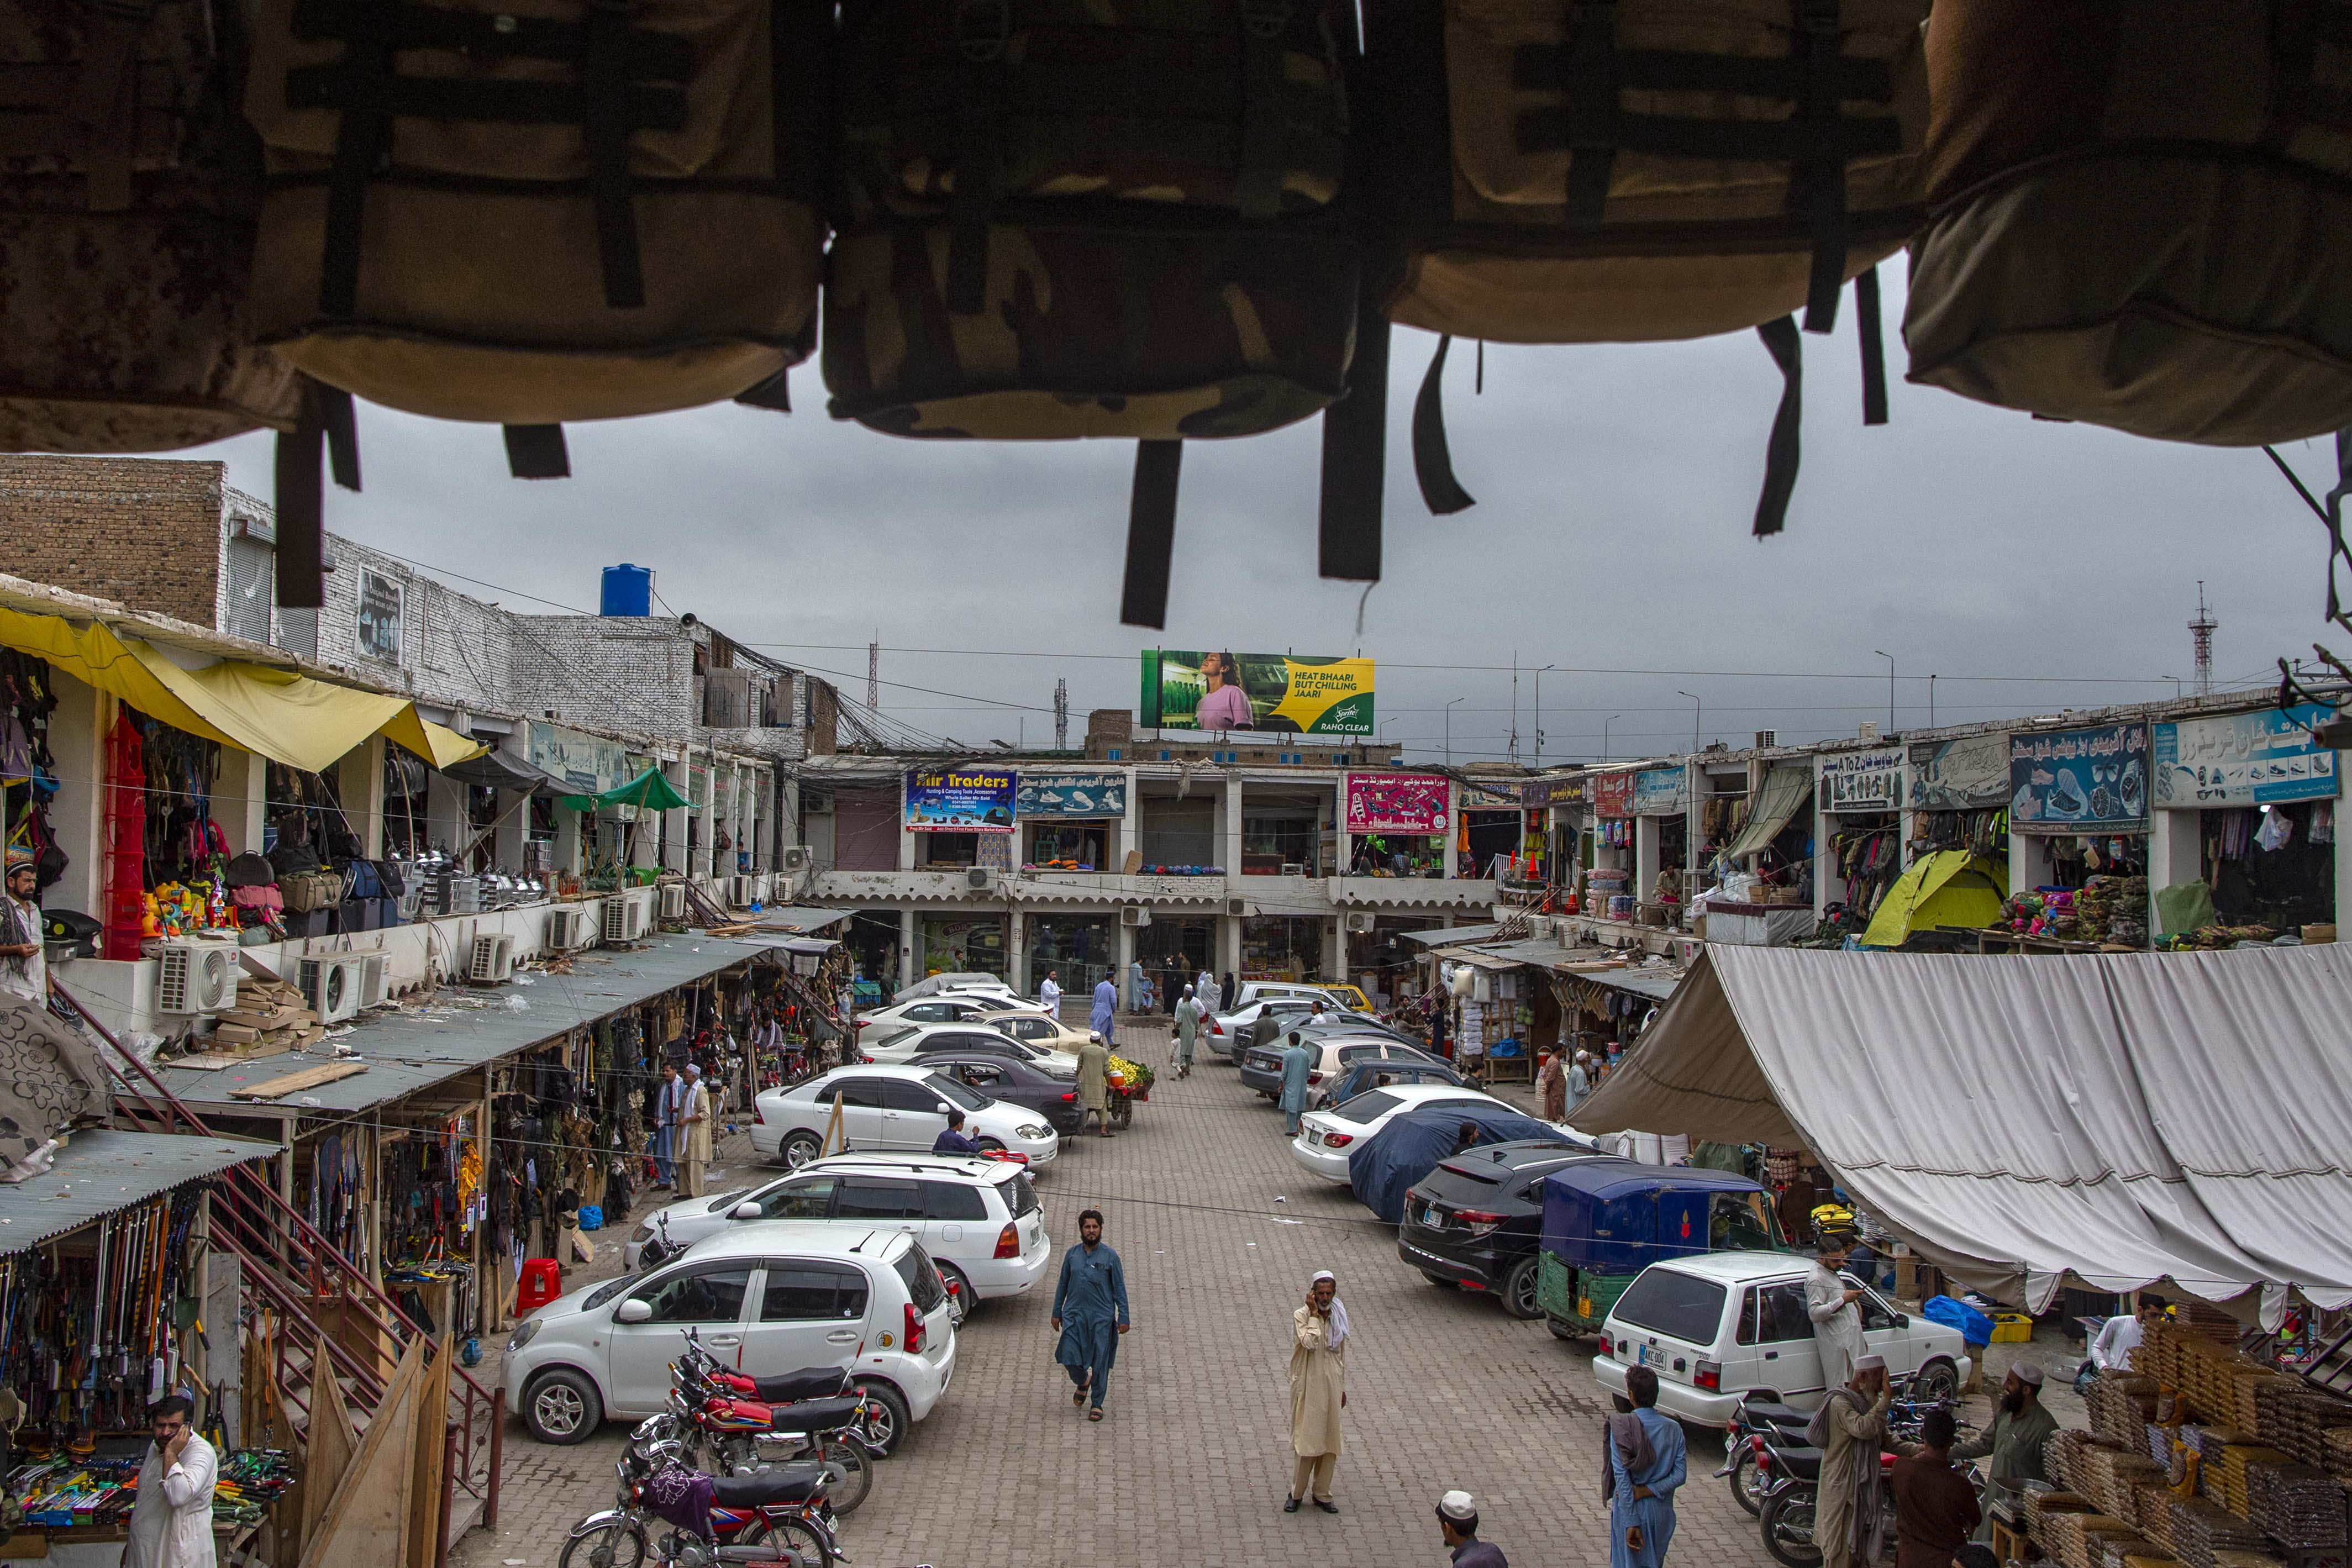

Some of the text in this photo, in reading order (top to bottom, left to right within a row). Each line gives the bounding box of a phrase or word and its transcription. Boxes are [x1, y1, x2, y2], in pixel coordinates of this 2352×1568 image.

[1295, 671, 1354, 682] HEAT BHAARI
[1295, 681, 1357, 691] BUT CHILLING
[1294, 688, 1320, 698] JAARI
[1337, 709, 1356, 719] Sprite
[1321, 723, 1343, 731] RAHO
[2089, 726, 2126, 756] آفریدی
[2236, 719, 2269, 760] خان
[2034, 738, 2051, 761] شوز
[1838, 757, 1844, 772] A
[1855, 756, 1860, 770] Z
[1861, 754, 1872, 770] خان
[916, 774, 1008, 788] Mir Traders
[1039, 778, 1053, 788] شوز
[1076, 775, 1104, 787] آفریدی
[1645, 1350, 1664, 1365] AKC-004
[1690, 1349, 1711, 1357] MEHRAN
